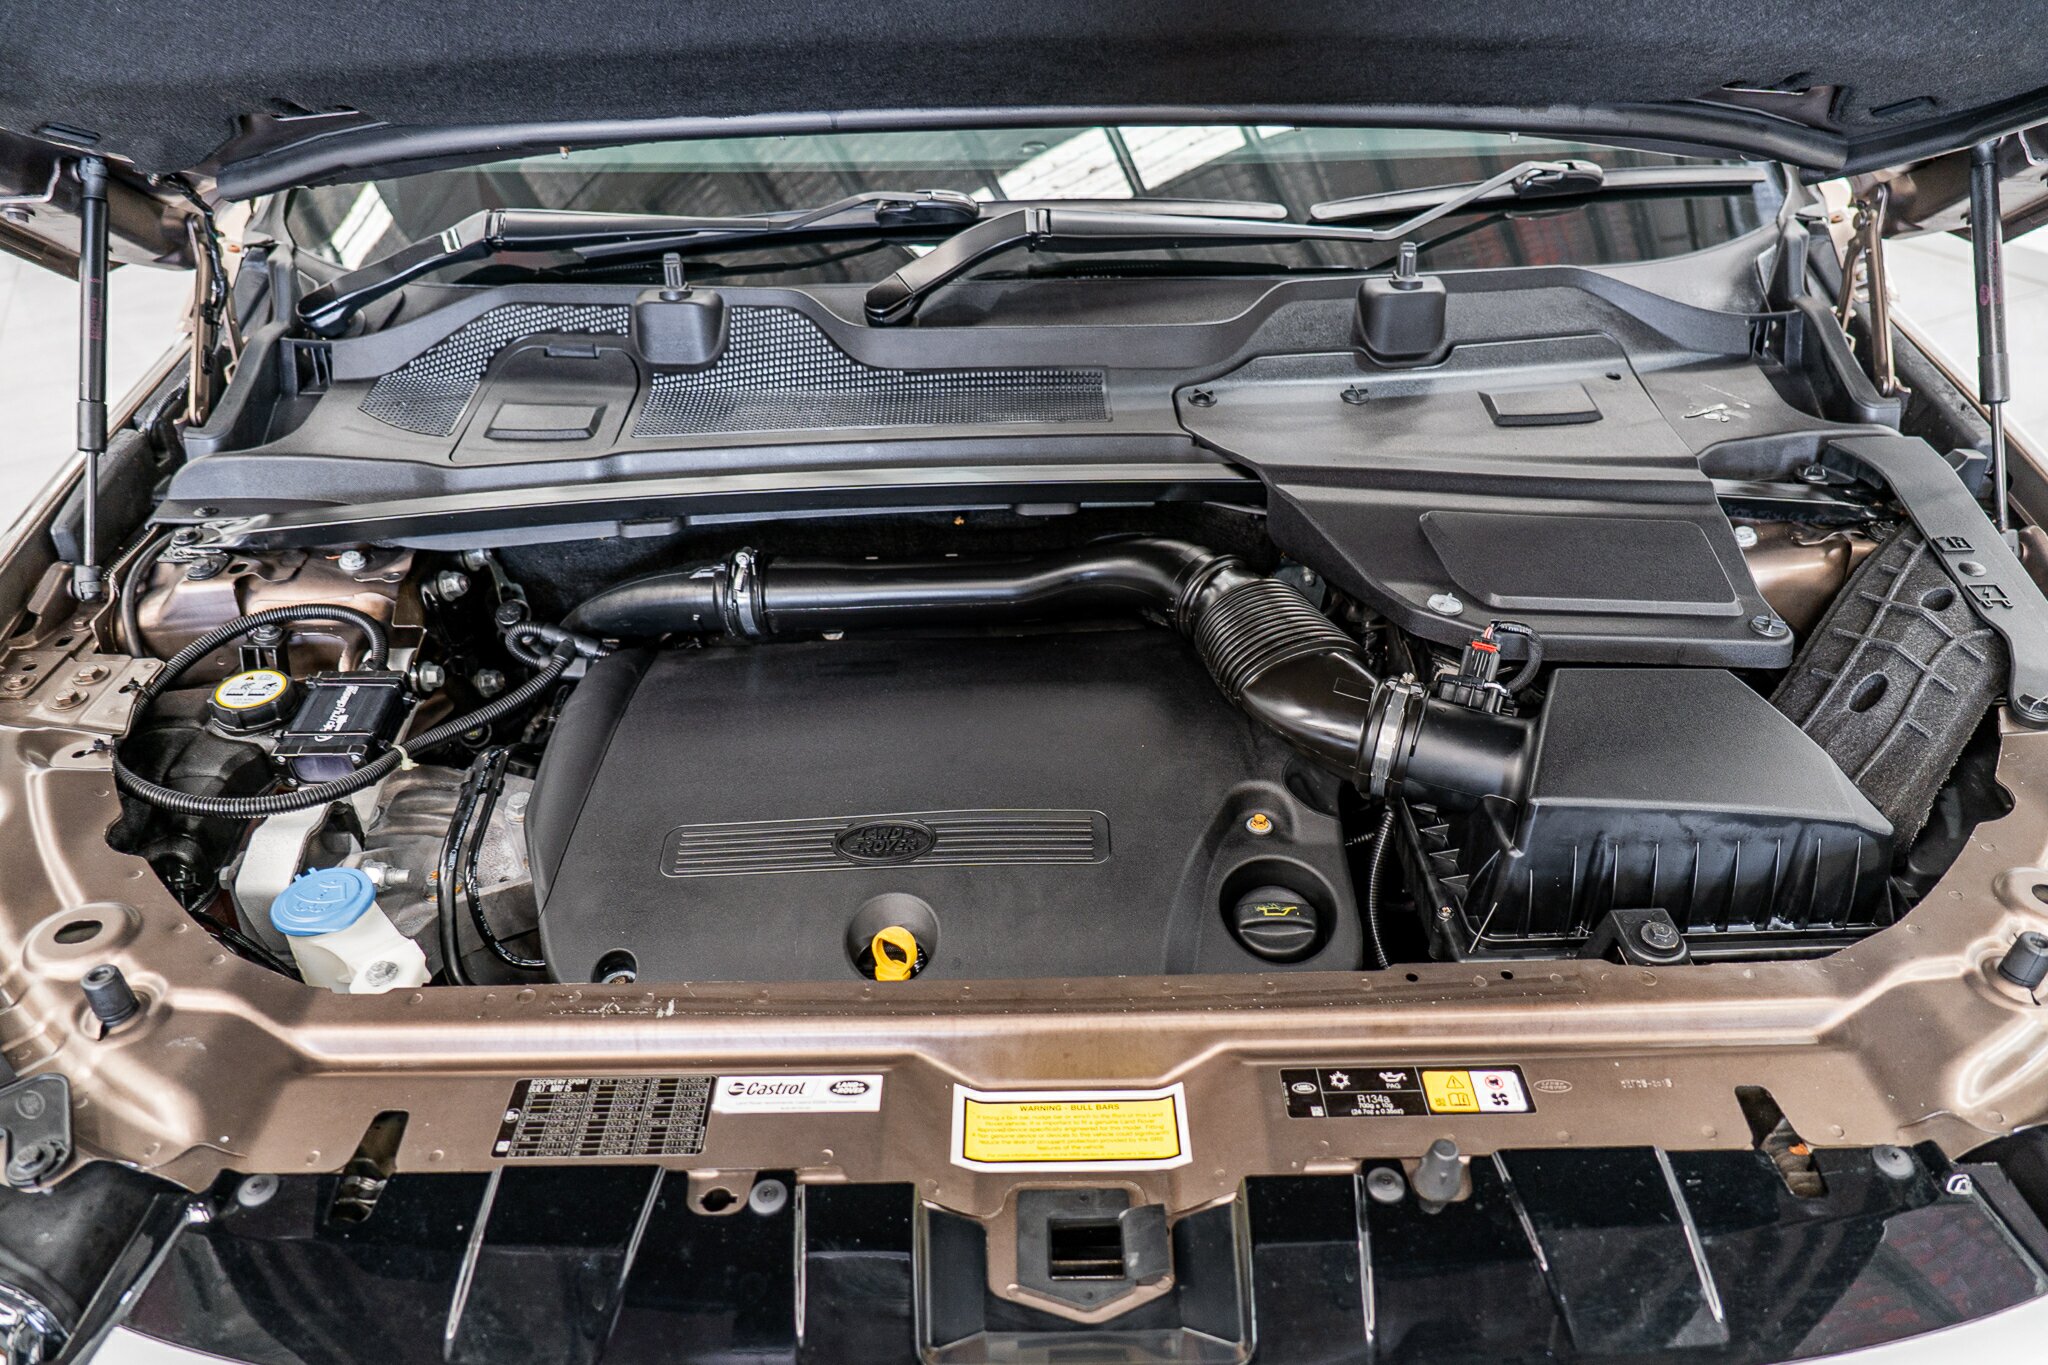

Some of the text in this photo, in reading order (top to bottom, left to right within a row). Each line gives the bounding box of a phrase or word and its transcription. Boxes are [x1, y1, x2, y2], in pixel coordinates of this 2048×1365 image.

[857, 827, 904, 841] LAND
[860, 838, 917, 852] ROVER
[531, 1078, 567, 1086] DISCOVERY
[746, 1082, 806, 1096] Castrol
[1357, 1095, 1391, 1104] R134a
